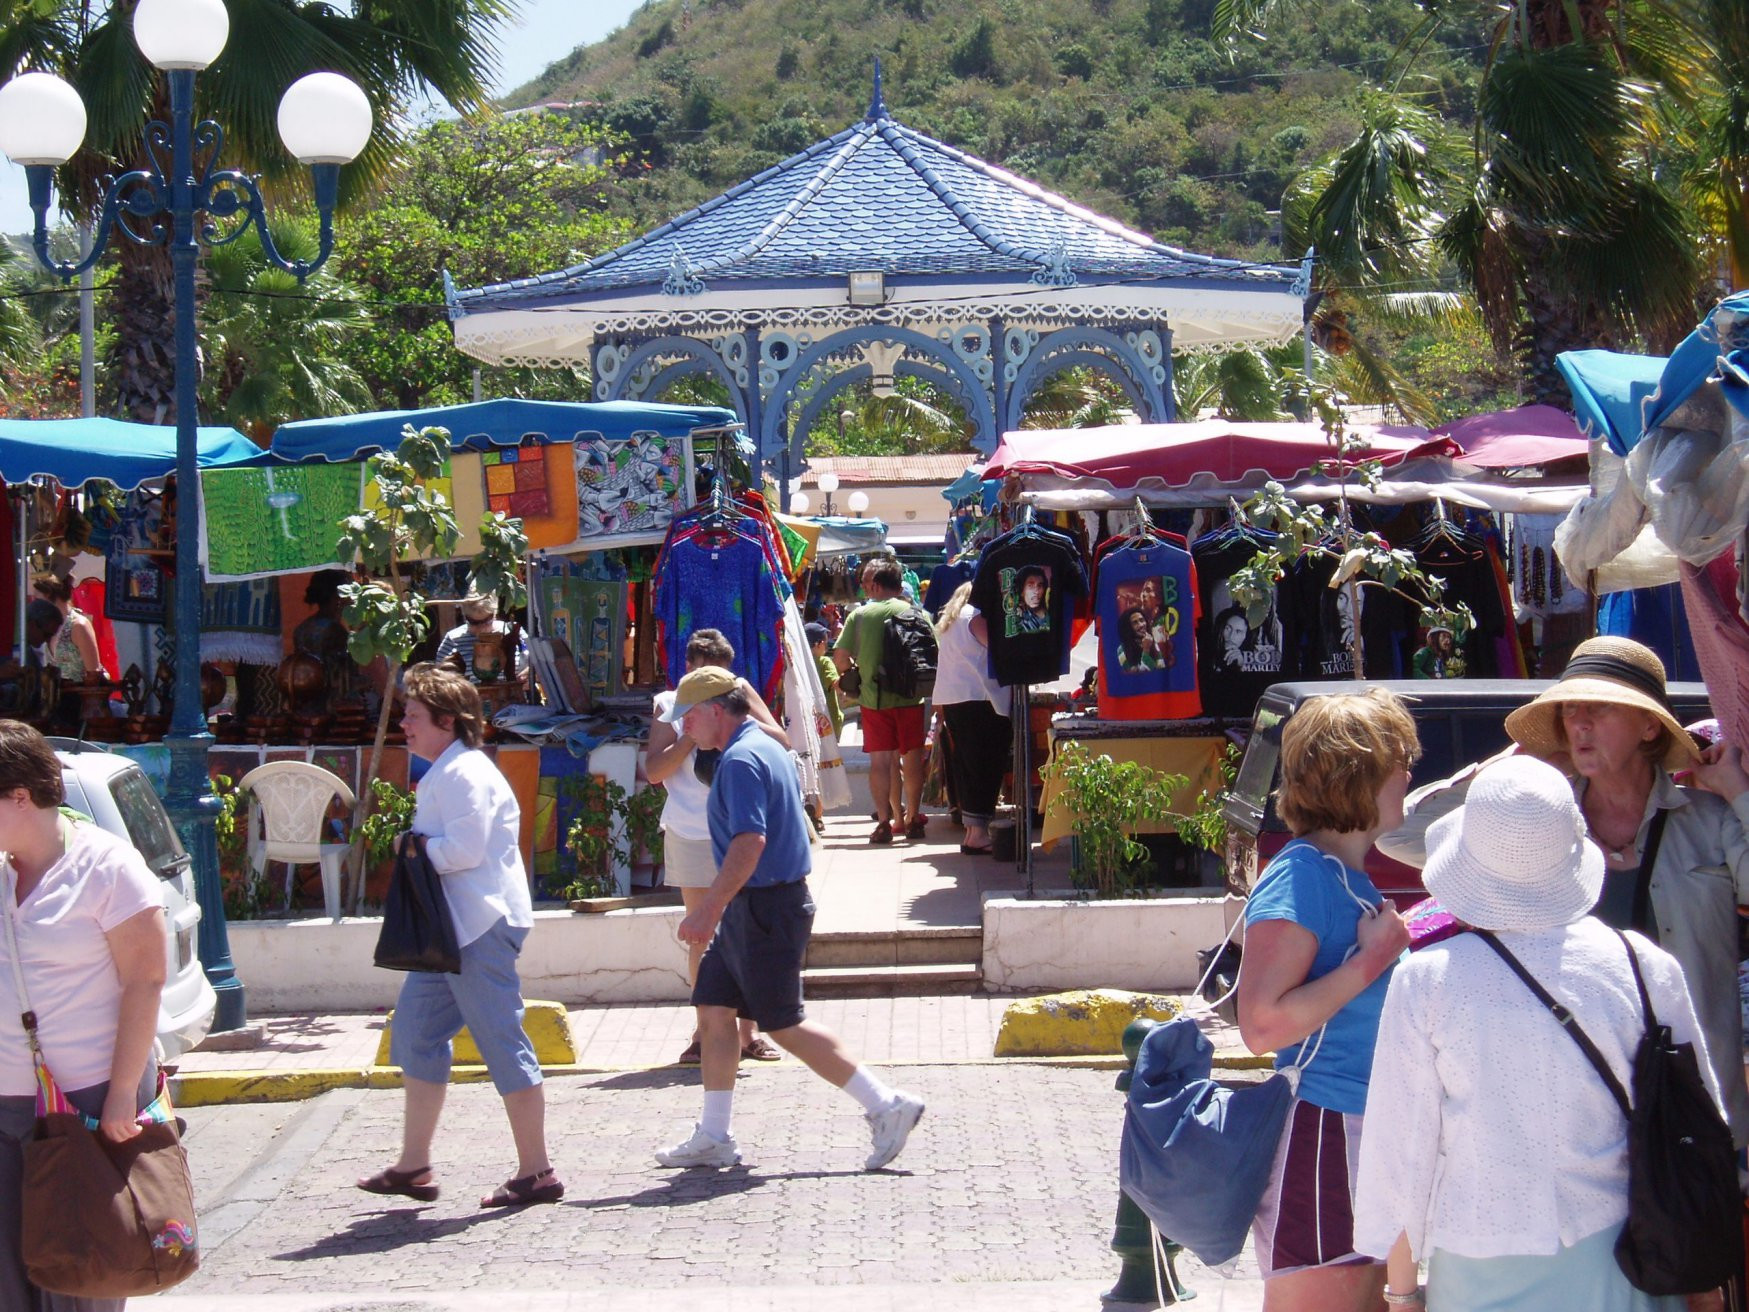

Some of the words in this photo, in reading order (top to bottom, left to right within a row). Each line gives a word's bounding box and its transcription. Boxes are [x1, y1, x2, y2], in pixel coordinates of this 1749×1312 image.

[999, 567, 1020, 638] BOB
[1243, 650, 1282, 664] BOB
[1241, 663, 1281, 672] MARLEY
[1321, 662, 1355, 675] MARL
